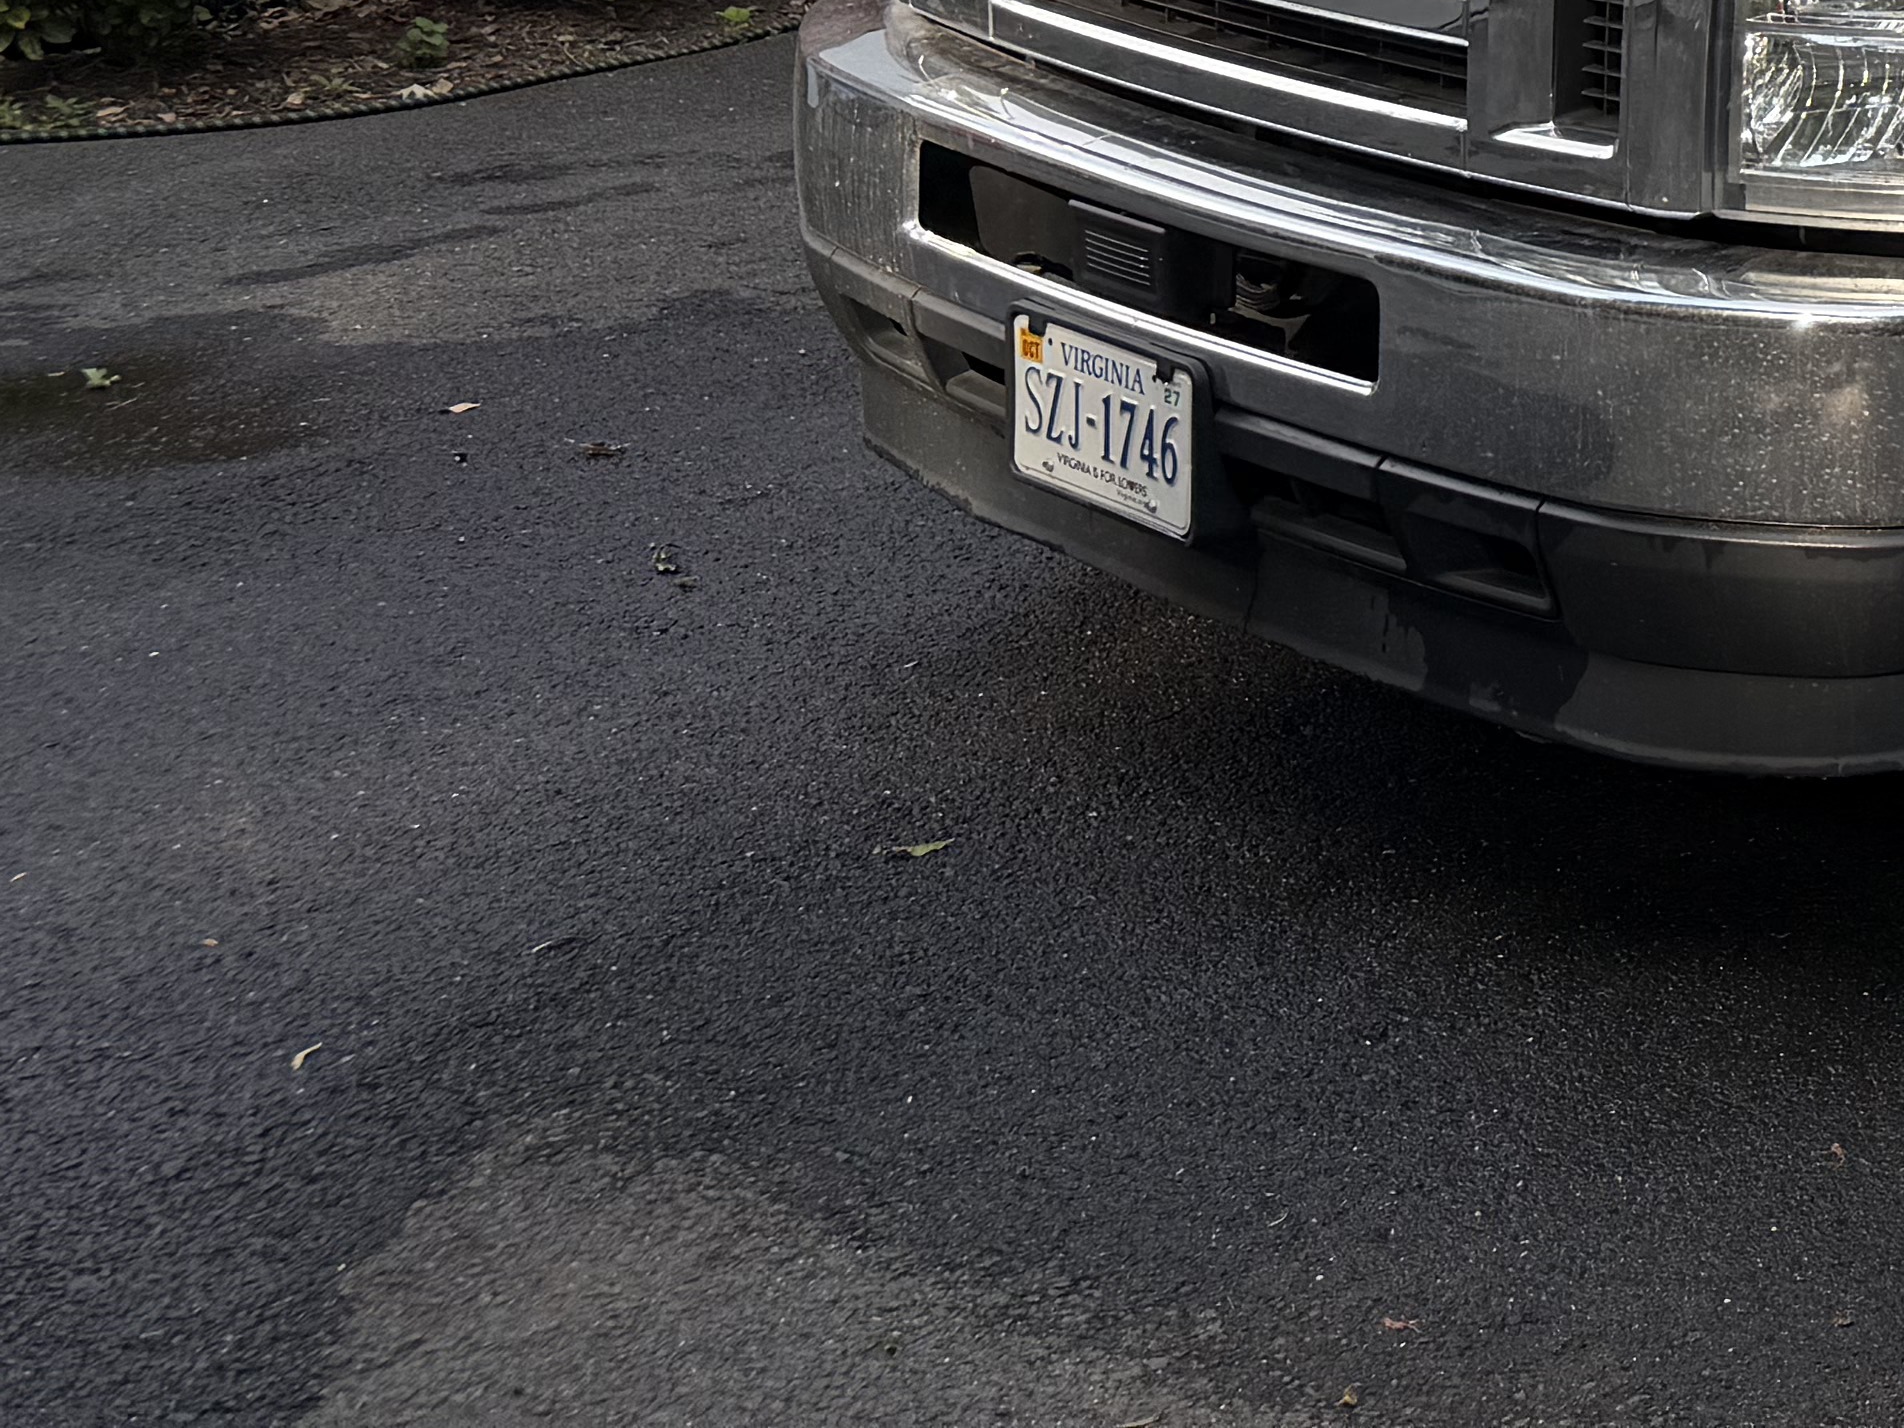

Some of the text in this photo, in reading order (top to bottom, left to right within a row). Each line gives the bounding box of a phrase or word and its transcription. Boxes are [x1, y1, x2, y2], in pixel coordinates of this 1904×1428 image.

[1060, 342, 1145, 395] VIRGINIA
[1163, 387, 1181, 407] 27
[1024, 366, 1180, 487] SZJ-1746
[1057, 452, 1092, 476] VIRGINIA
